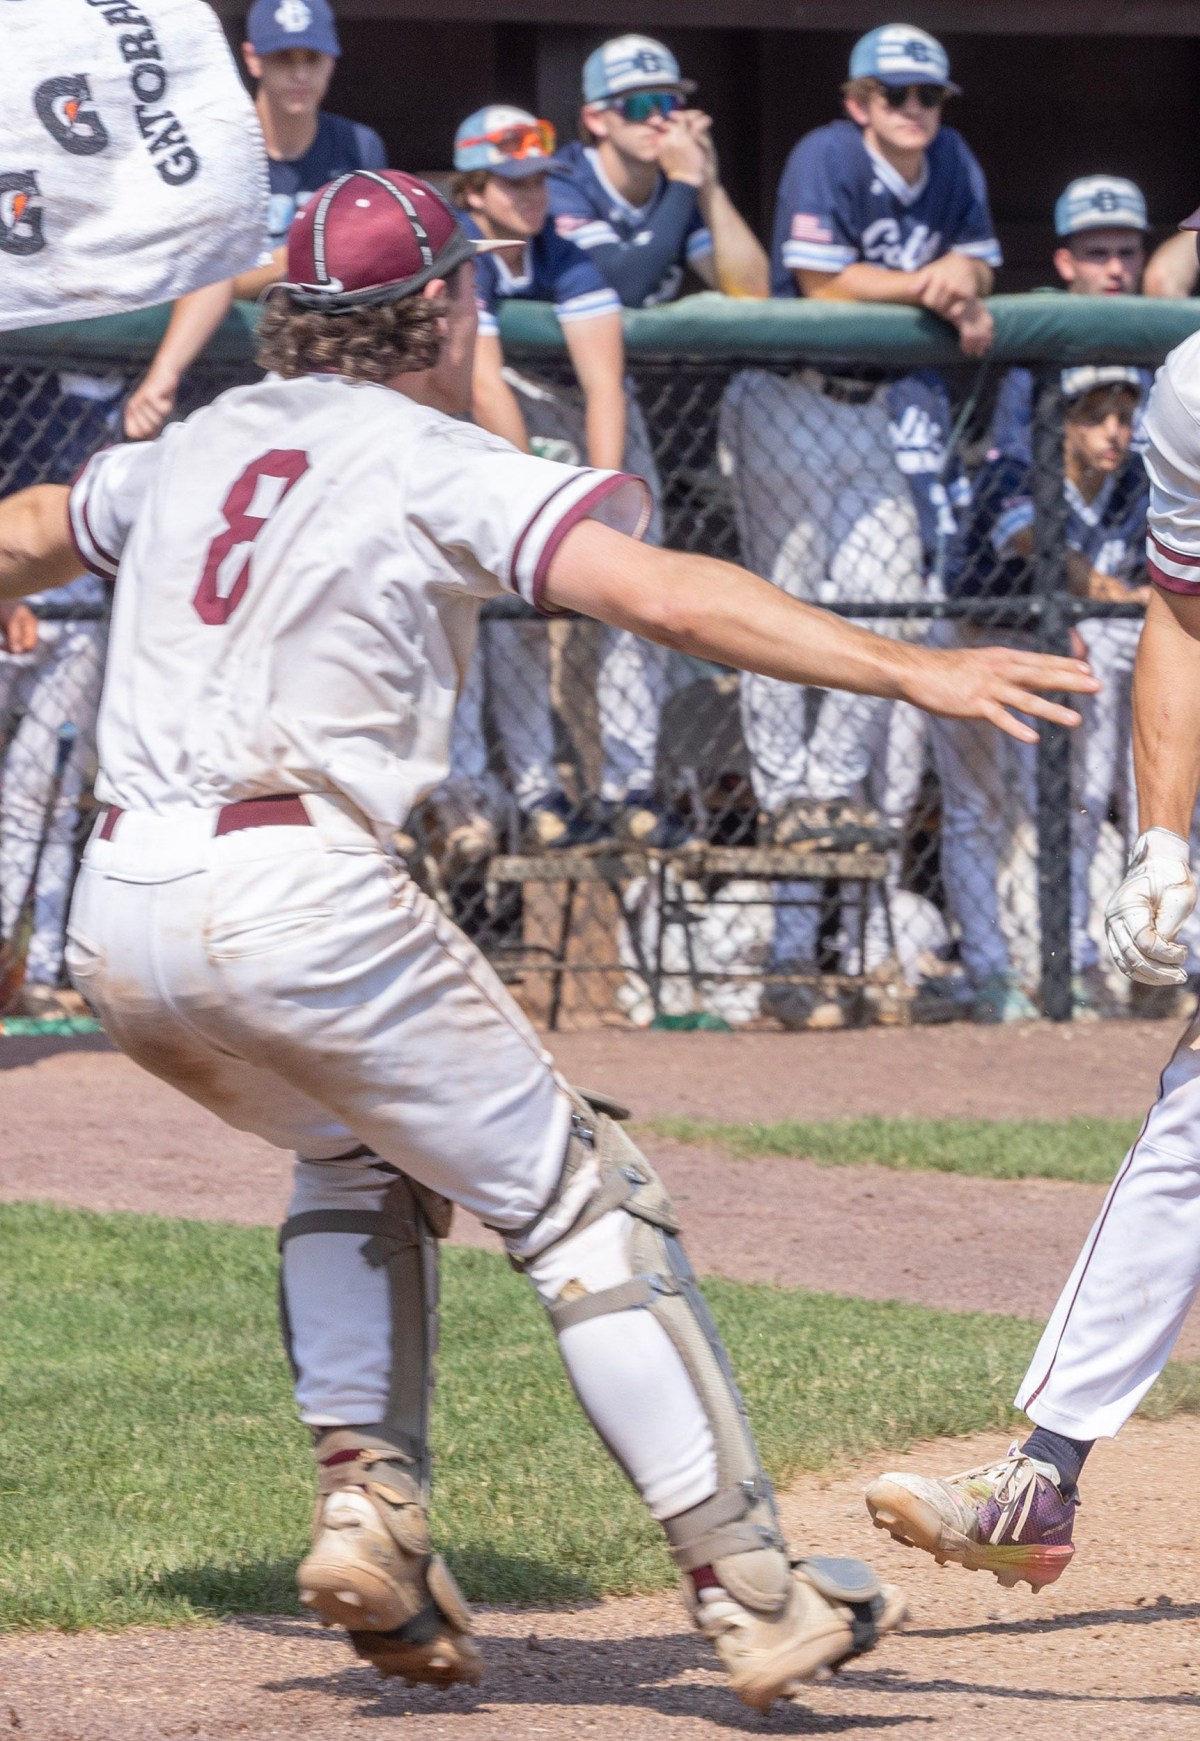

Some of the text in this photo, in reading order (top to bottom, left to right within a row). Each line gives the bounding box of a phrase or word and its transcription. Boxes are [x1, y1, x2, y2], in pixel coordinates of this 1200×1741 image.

[33, 72, 110, 156] G
[85, 0, 201, 187] GATORA
[192, 448, 313, 626] 8
